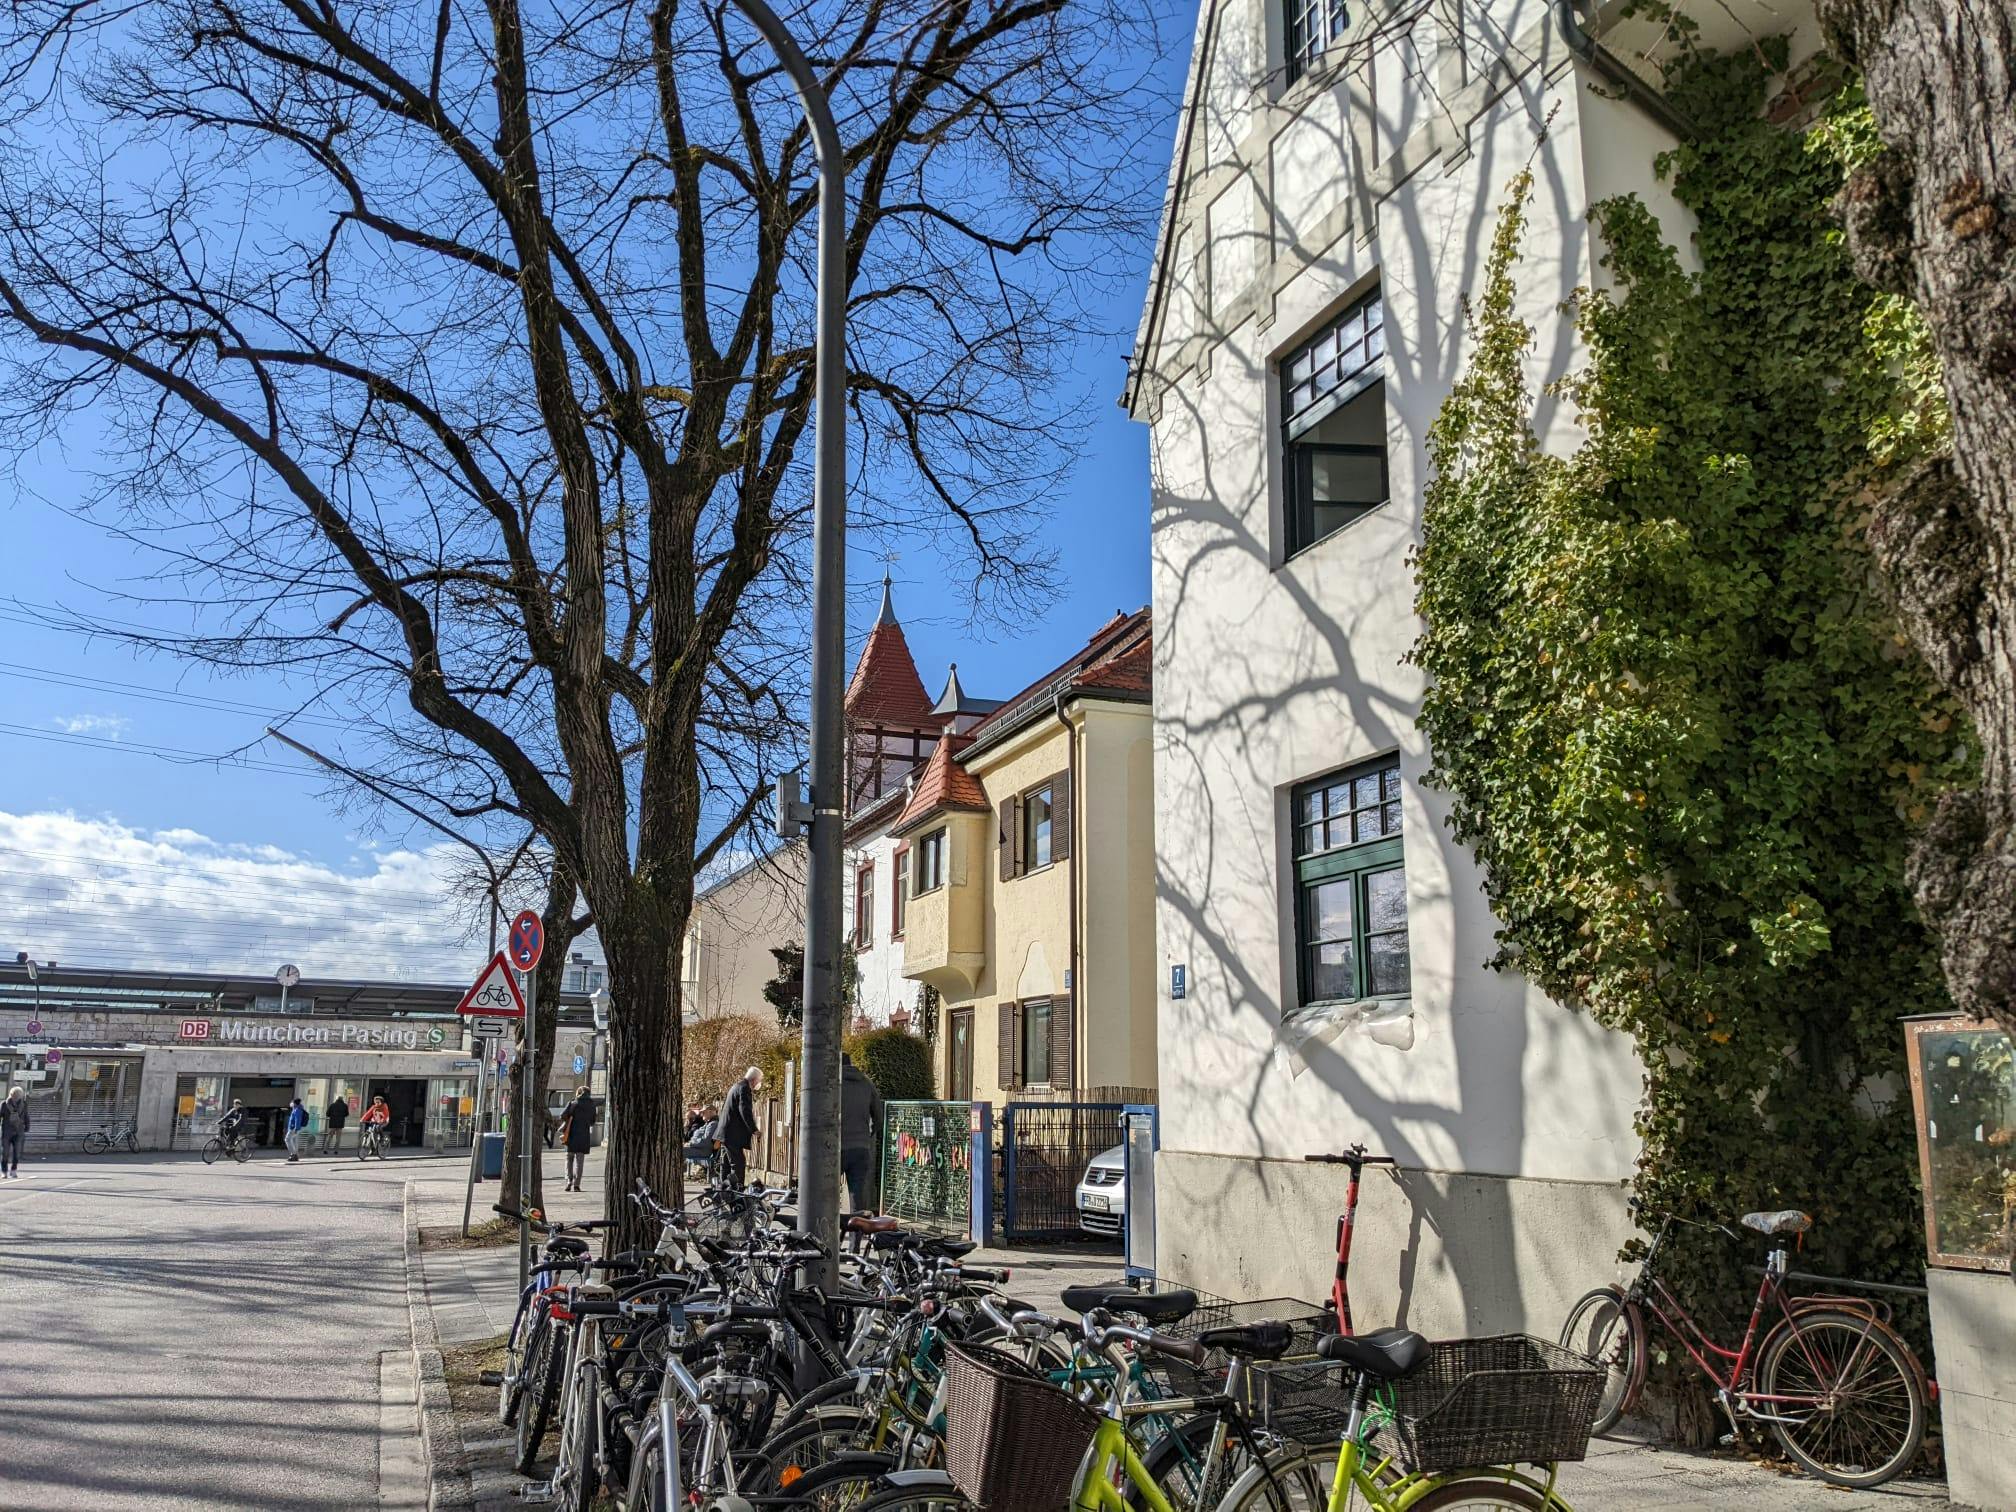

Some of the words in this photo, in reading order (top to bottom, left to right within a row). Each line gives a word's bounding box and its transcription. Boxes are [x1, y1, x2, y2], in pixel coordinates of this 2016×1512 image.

[184, 1022, 206, 1036] DB
[220, 1020, 417, 1049] München-Pasing
[429, 1027, 443, 1043] S
